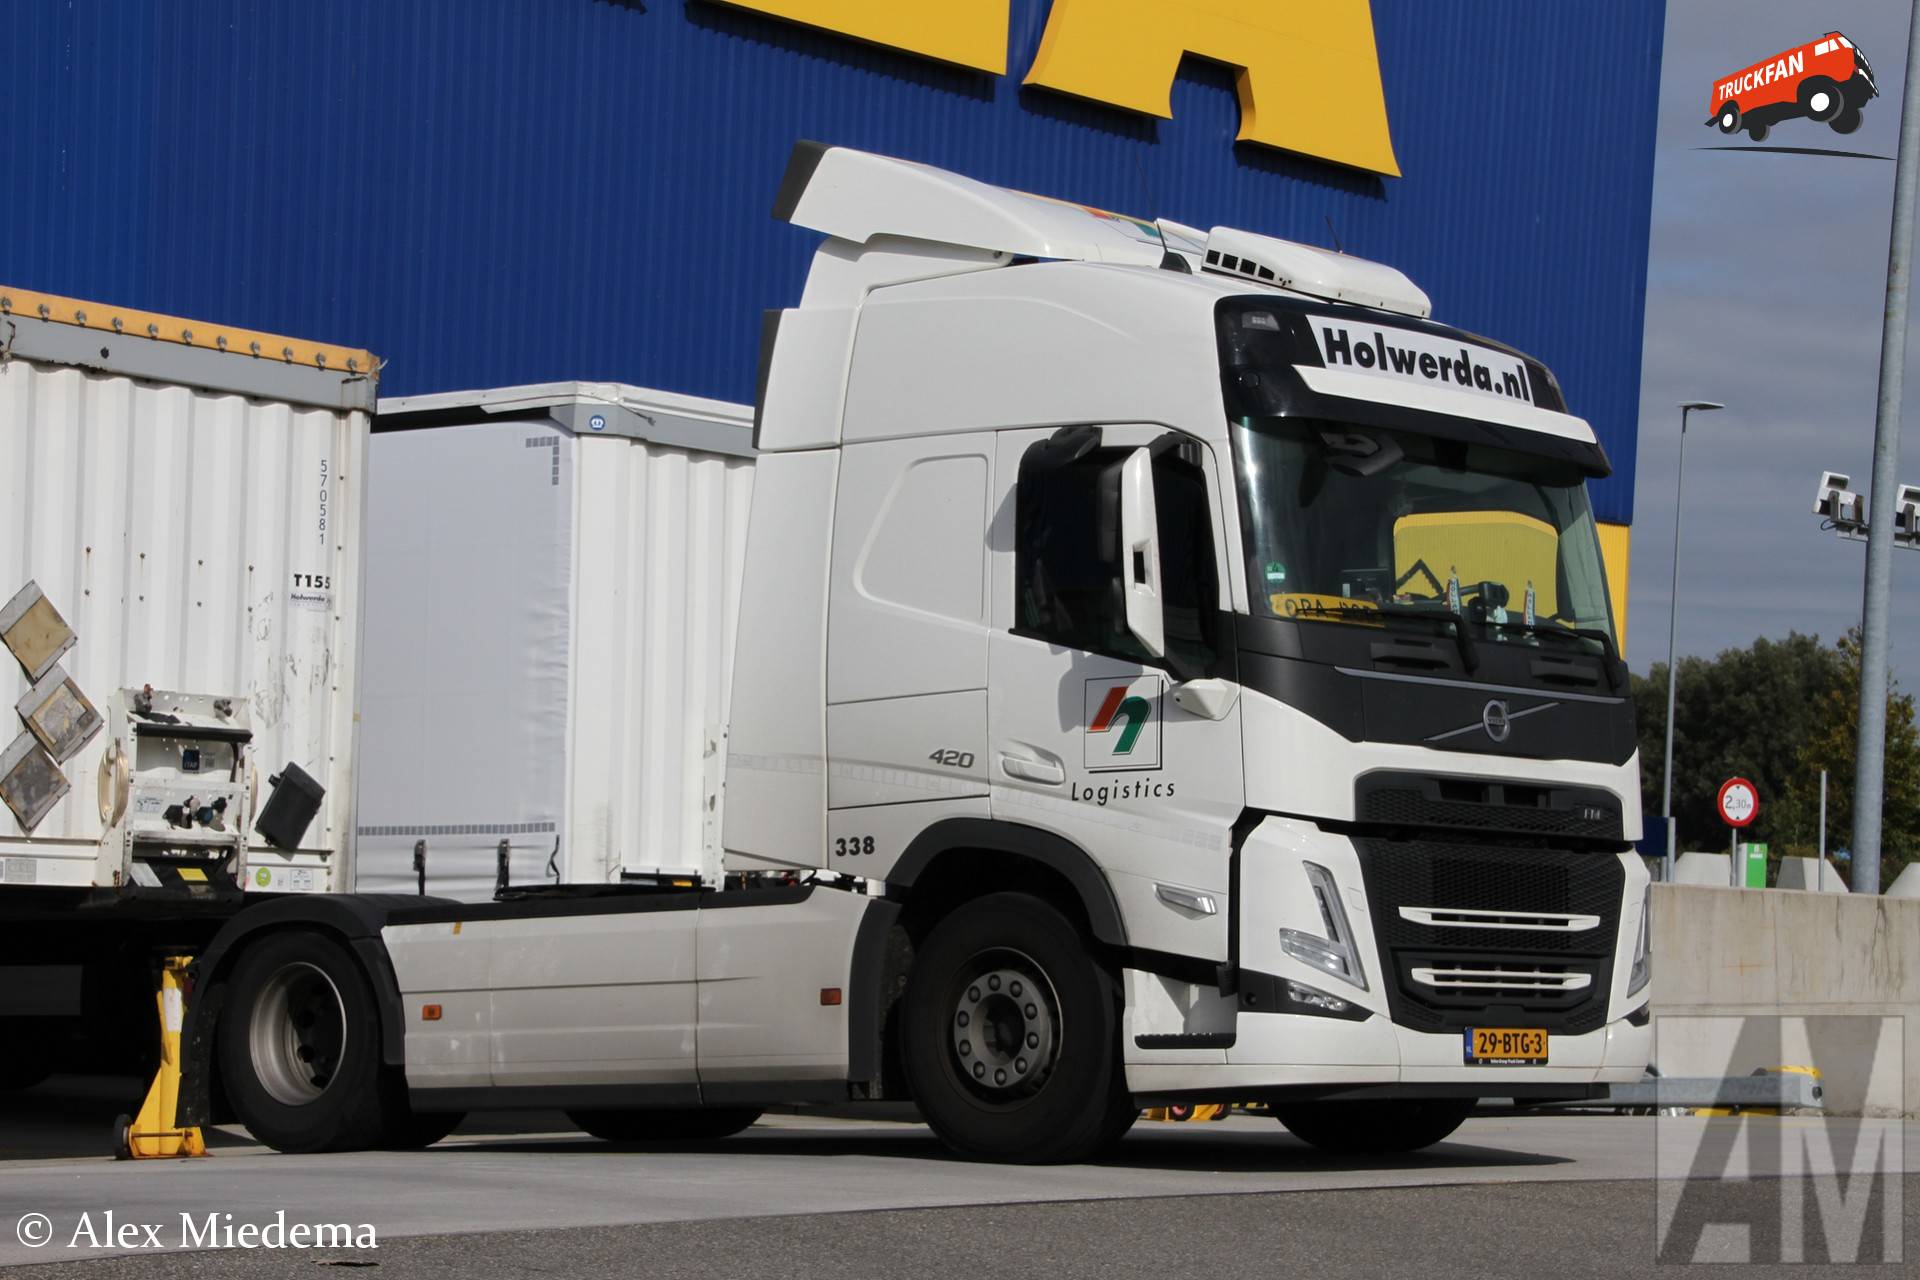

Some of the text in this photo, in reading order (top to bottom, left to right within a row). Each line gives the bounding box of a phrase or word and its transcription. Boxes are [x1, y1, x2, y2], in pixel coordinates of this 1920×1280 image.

[1322, 327, 1531, 402] Holwerda.nl
[318, 458, 328, 546] 570581
[293, 573, 331, 590] T155
[928, 748, 976, 769] 420
[1071, 777, 1176, 807] Logistics
[834, 836, 876, 858] 338
[1479, 1031, 1543, 1054] 29-BTG-3
